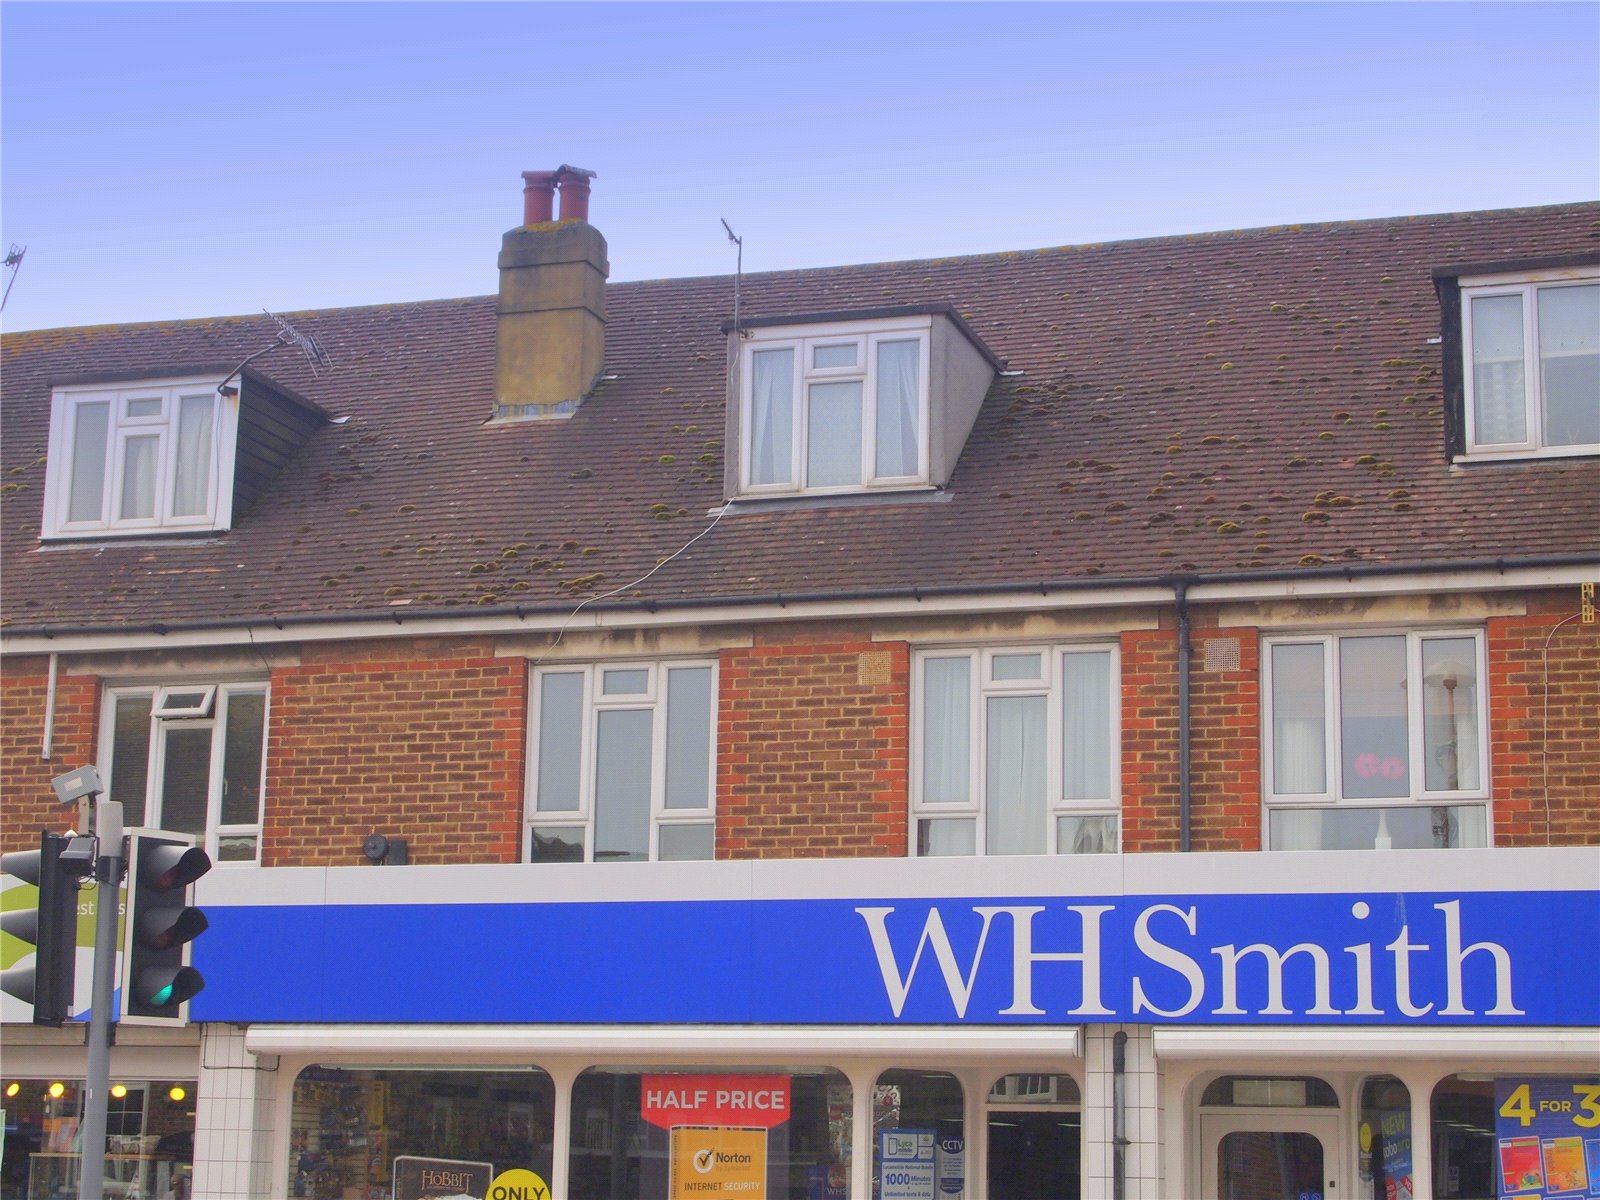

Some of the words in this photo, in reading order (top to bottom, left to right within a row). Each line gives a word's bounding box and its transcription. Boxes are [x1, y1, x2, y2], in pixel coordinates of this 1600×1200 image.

[855, 899, 1526, 1018] WHSmith
[646, 1090, 708, 1109] HALF
[716, 1090, 785, 1110] PRICE
[1498, 1083, 1536, 1127] 4
[1539, 1100, 1572, 1113] FOR
[1572, 1084, 1600, 1128] 3
[942, 1140, 963, 1150] CCTV
[716, 1152, 751, 1163] Norton
[885, 1173, 910, 1185] 1000
[492, 1186, 546, 1200] ONLY
[685, 1182, 722, 1191] INTERNET
[723, 1182, 760, 1191] SECURITY
